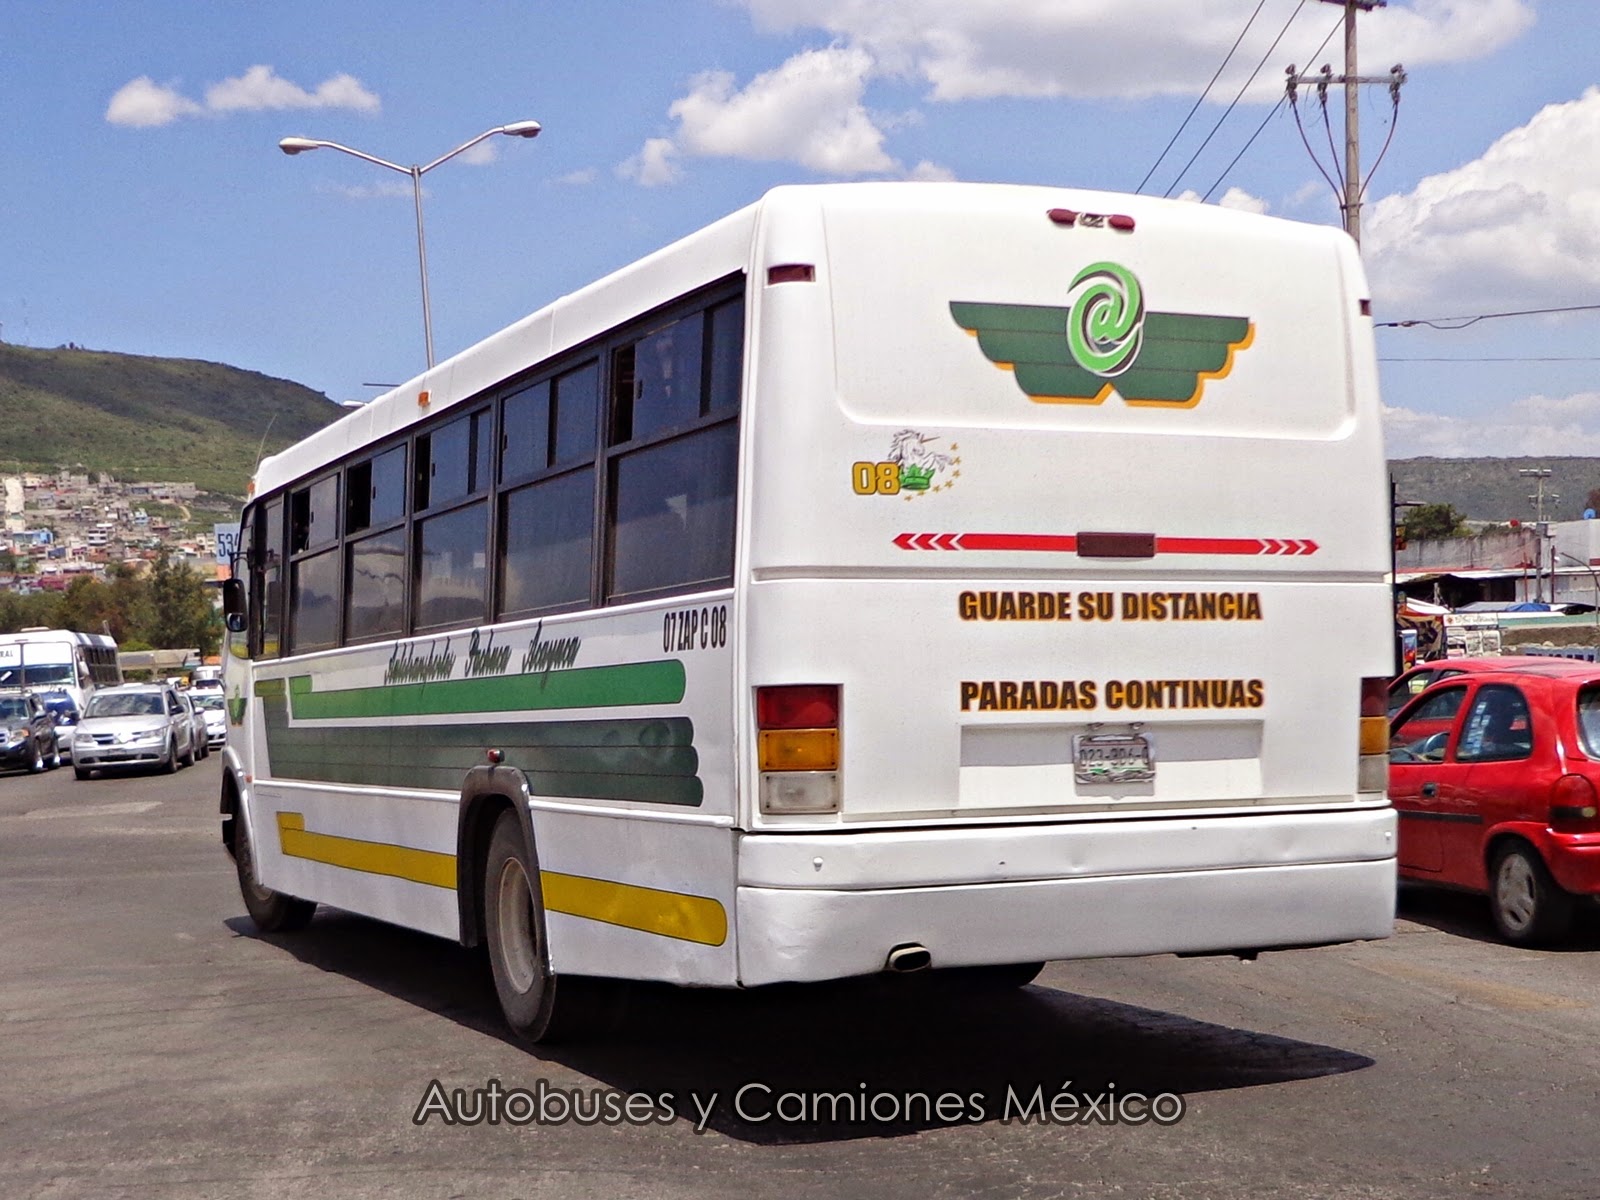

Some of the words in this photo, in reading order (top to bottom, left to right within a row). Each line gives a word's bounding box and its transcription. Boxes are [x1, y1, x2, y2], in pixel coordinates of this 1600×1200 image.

[851, 461, 900, 495] 08
[958, 590, 1072, 621] GUARDE
[1077, 591, 1114, 621] SU
[1121, 591, 1263, 621] DISTANCIA
[960, 680, 1097, 711] PARADAS
[1104, 679, 1264, 710] CONTINUAS
